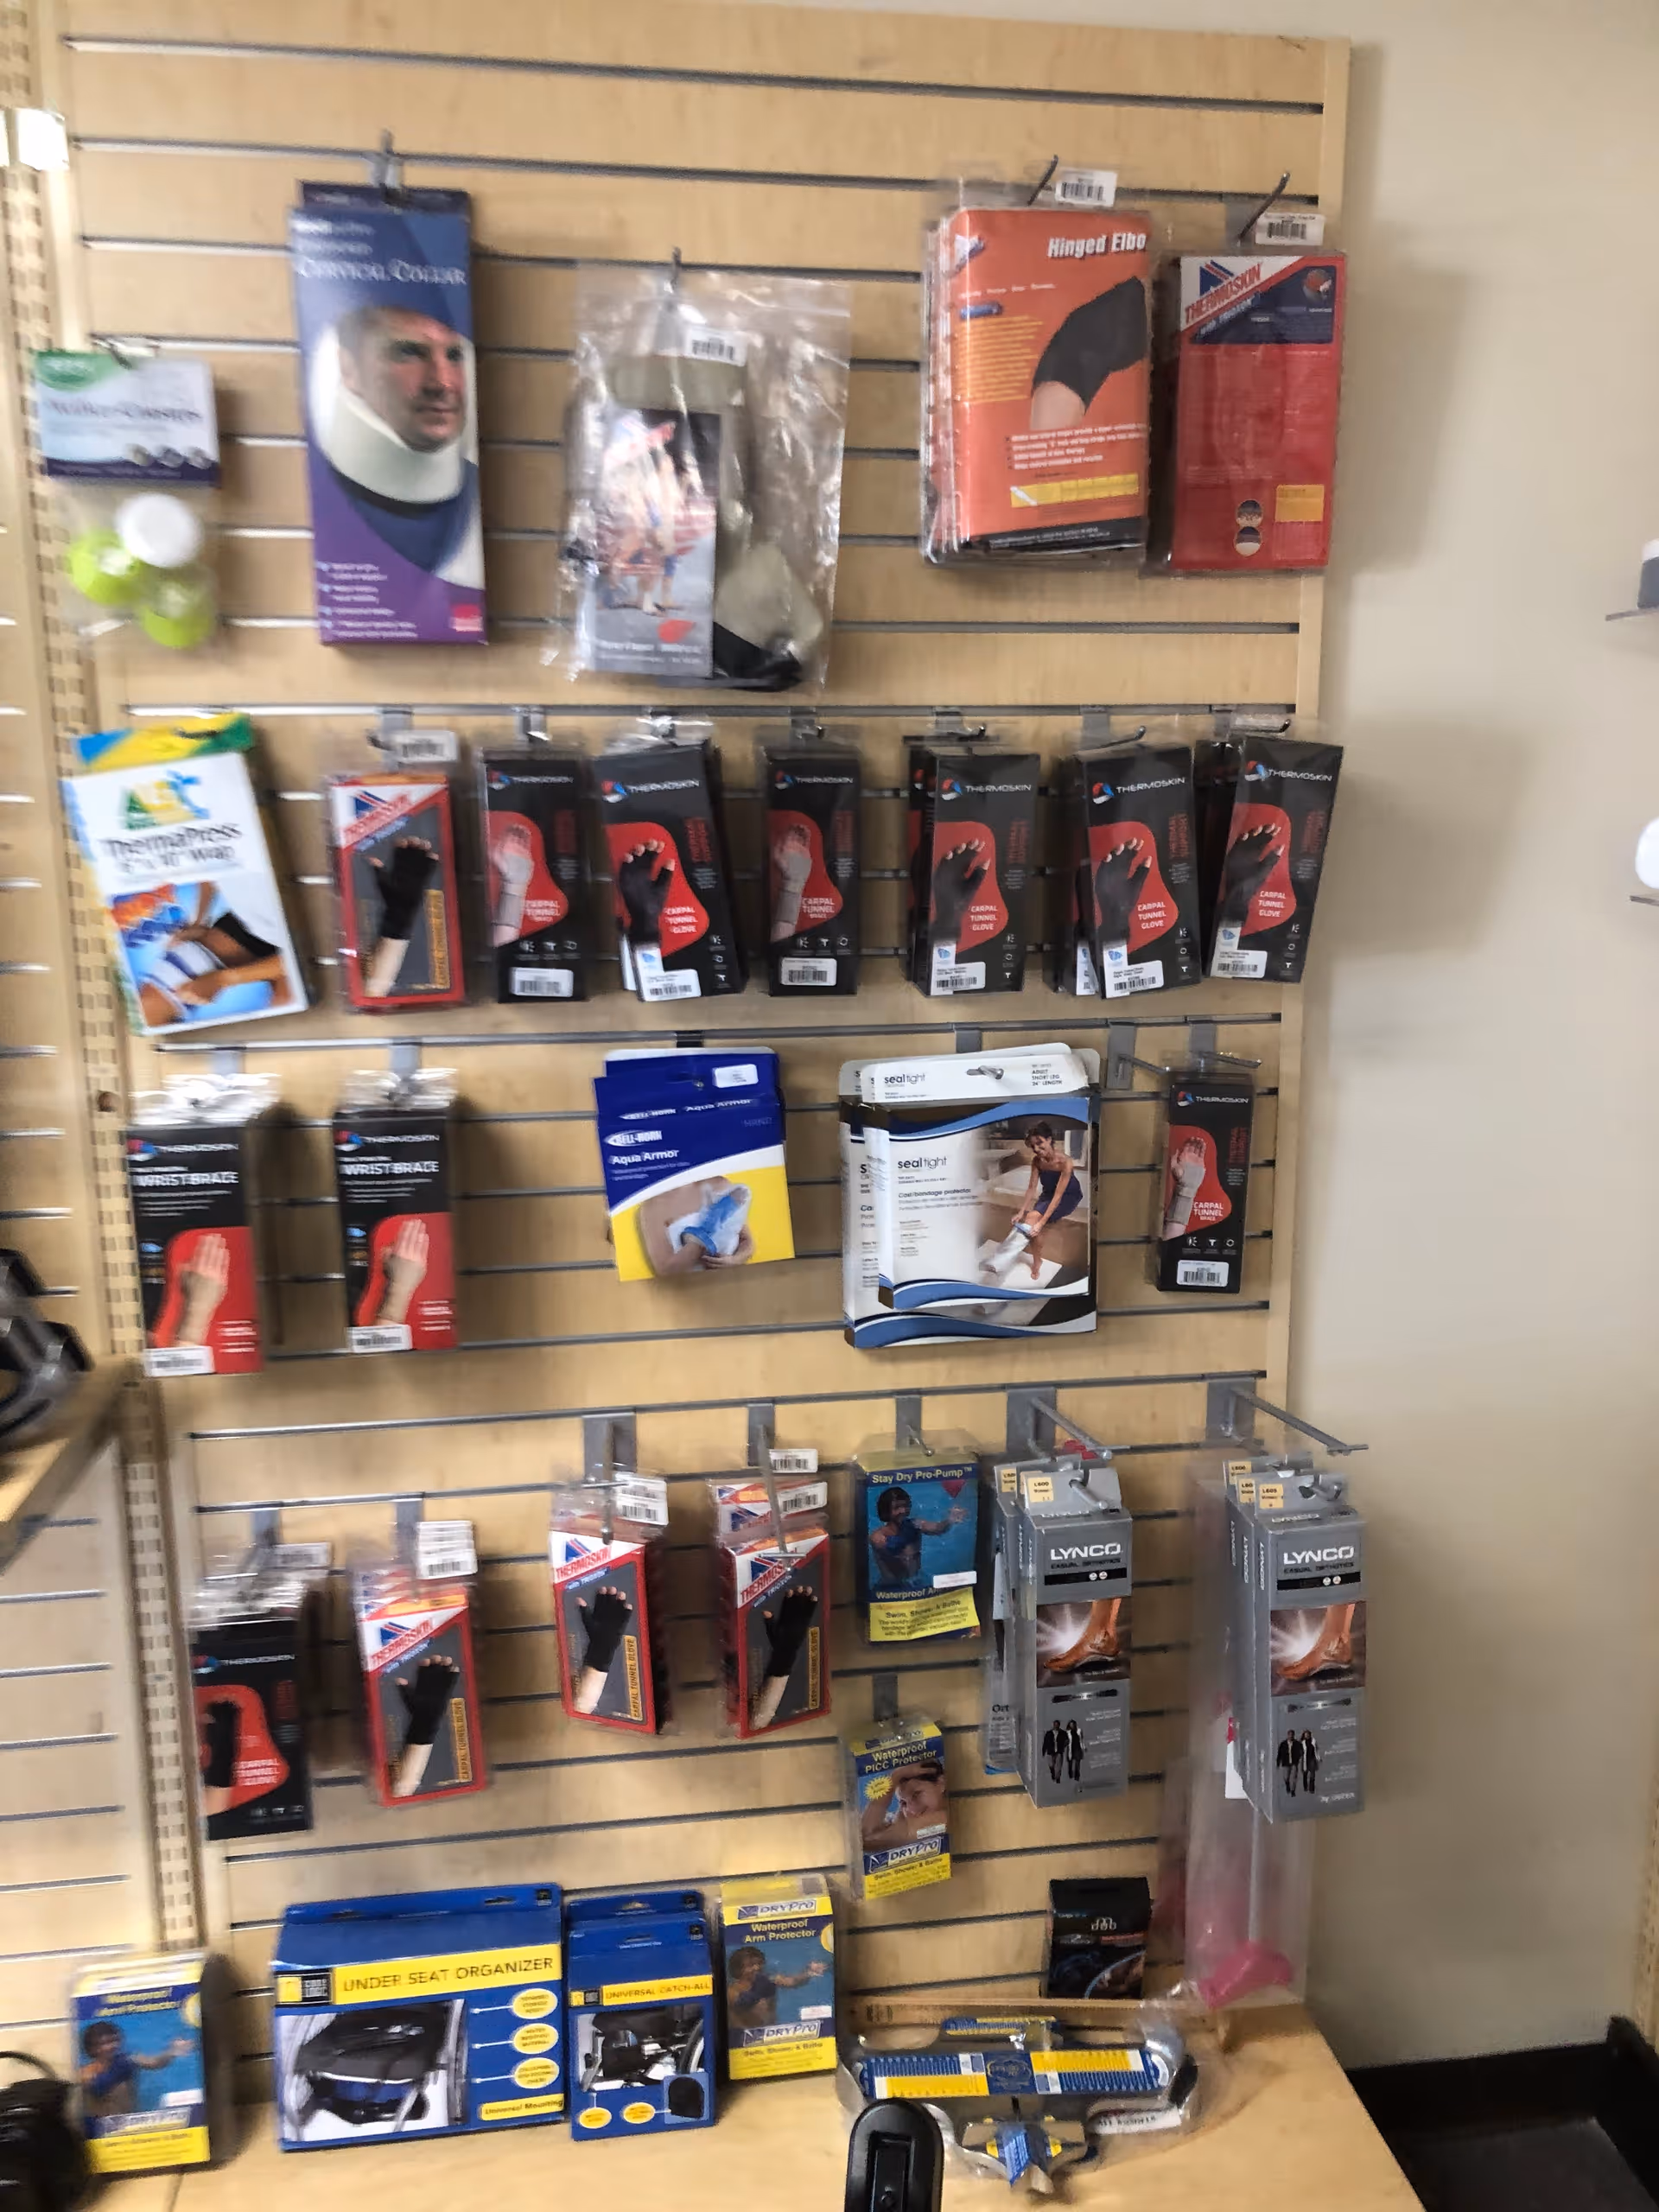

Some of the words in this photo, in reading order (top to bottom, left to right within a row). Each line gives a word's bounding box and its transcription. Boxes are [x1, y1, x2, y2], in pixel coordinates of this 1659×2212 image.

[1047, 235, 1107, 258] Hinged
[1111, 232, 1147, 252] Elbo
[1268, 768, 1332, 782] THERMOSKIN
[1116, 777, 1185, 794] THERMOSKIN
[1260, 890, 1286, 899] CARPAL
[803, 898, 835, 906] CARPAL
[1137, 901, 1166, 912] CARPAL
[1258, 899, 1285, 908] TUNNEL
[1138, 911, 1166, 921] TUNNEL
[1259, 909, 1281, 918] GLOVE
[1141, 920, 1164, 930] GLOVE
[611, 1154, 641, 1166] Aqua
[643, 1149, 679, 1161] Armor
[872, 1474, 893, 1484] Stay
[896, 1472, 912, 1483] Dry
[1050, 1542, 1121, 1560] LYNCO
[1283, 1546, 1354, 1565] LYNCO
[556, 1546, 611, 1580] THERMOSKIN
[876, 1588, 926, 1599] Waterproof
[872, 1740, 927, 1762] Waterproof
[866, 1760, 890, 1774] PICC
[893, 1750, 937, 1767] Protector
[751, 1919, 808, 1932] Waterproof
[745, 1935, 766, 1943] Arm
[769, 1929, 816, 1941] Protector
[343, 1975, 402, 1992] UNDER
[408, 1969, 449, 1984] SEAT
[456, 1958, 553, 1979] ORGANIZER
[606, 1989, 656, 1999] UNIVERSAL
[525, 2100, 563, 2109] Mounting
